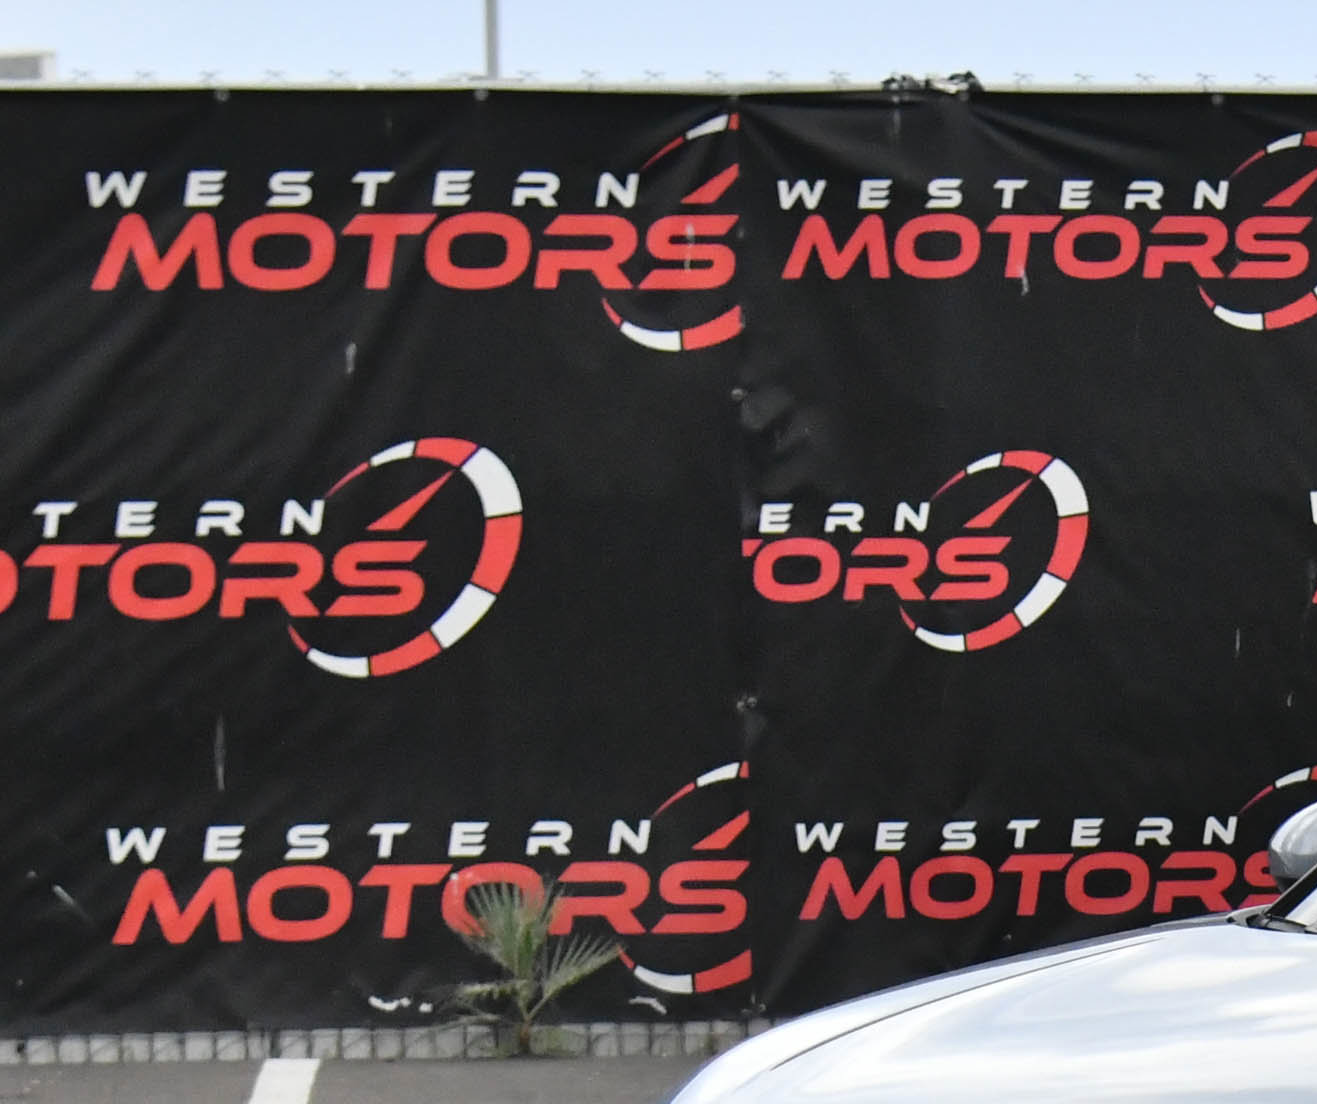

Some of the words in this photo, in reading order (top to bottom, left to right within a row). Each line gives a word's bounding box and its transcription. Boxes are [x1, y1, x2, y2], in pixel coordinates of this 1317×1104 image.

[86, 170, 639, 208] WESTERN
[777, 178, 1229, 211] WESTERN
[91, 211, 740, 292] MOTORS
[782, 212, 1313, 281] MOTORS
[32, 499, 325, 538] TERN
[758, 501, 930, 534] ERN
[0, 540, 428, 621] TORS
[741, 535, 1012, 604] ORS
[106, 818, 651, 865] WESTERN
[795, 814, 1238, 854] WESTERN
[111, 859, 750, 946] MOTORS
